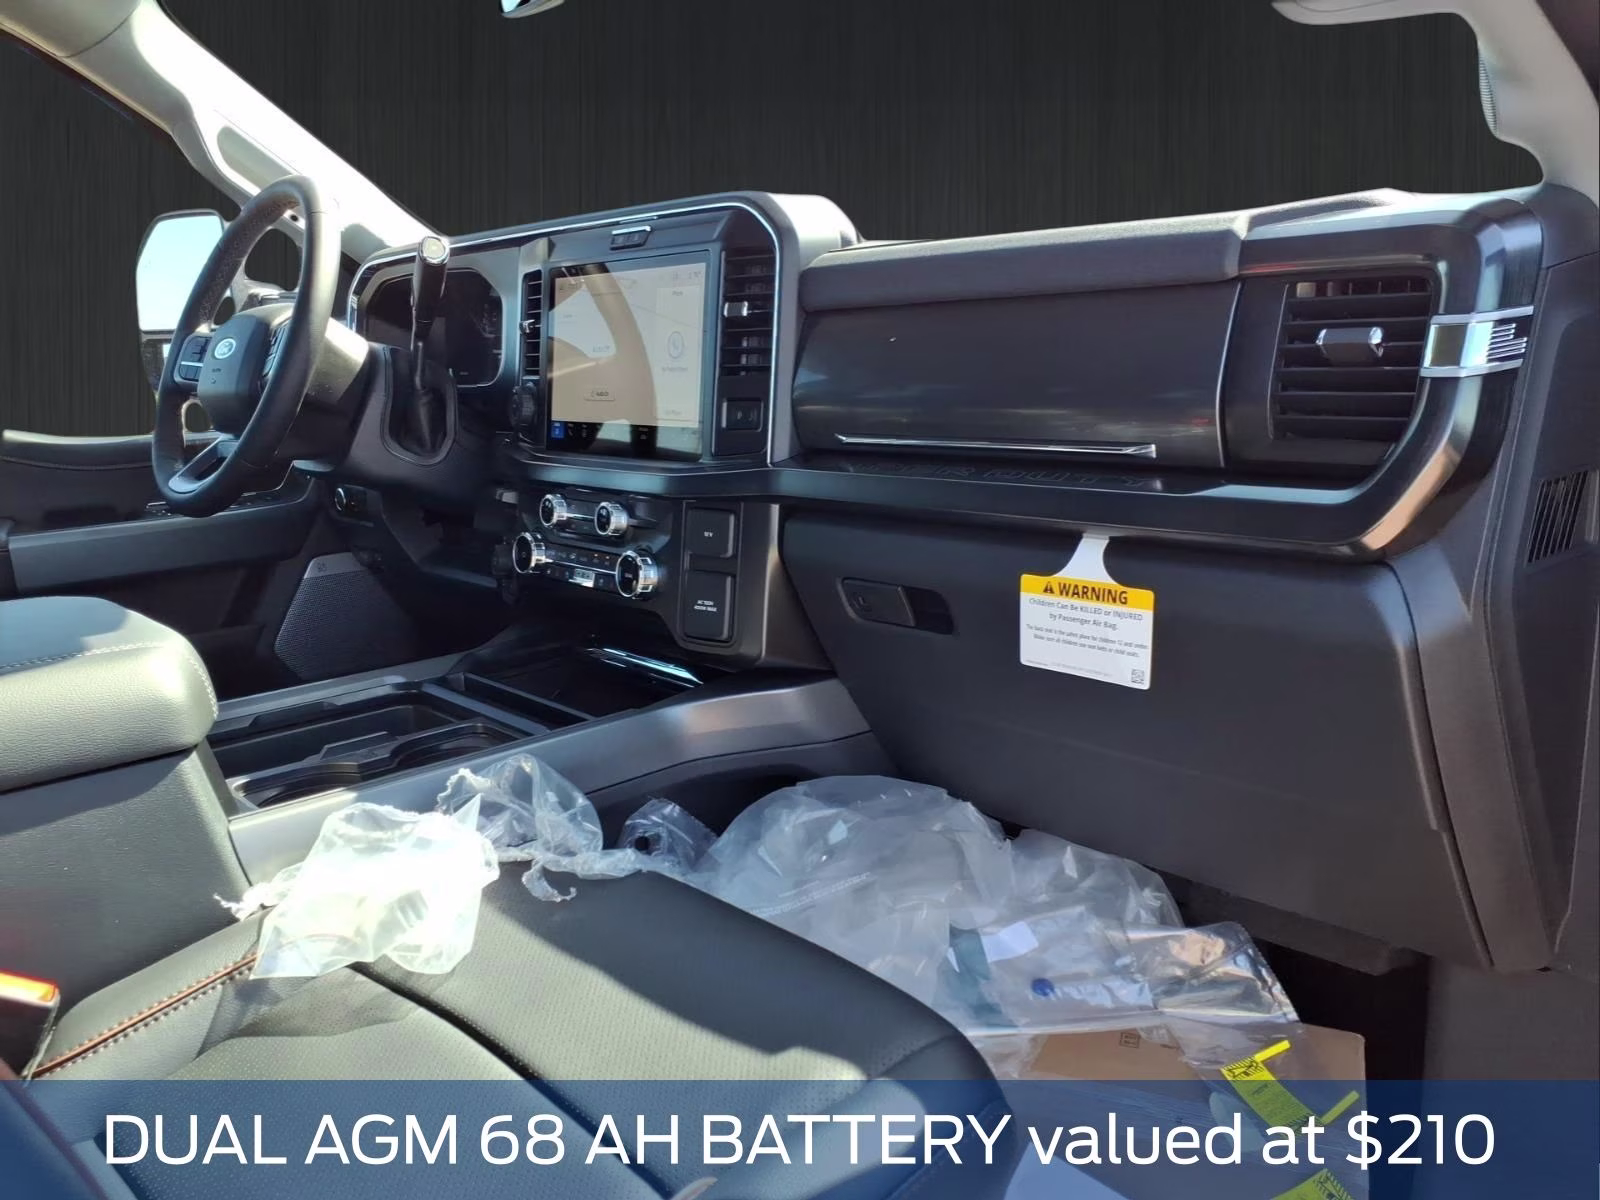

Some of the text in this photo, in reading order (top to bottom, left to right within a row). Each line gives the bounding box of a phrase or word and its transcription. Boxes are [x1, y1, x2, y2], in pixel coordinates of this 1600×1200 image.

[1058, 582, 1128, 605] WARNING
[1029, 597, 1056, 607] Children
[1056, 601, 1070, 610] Can
[1070, 603, 1079, 611] Be
[1080, 605, 1103, 615] KILLED
[1112, 610, 1143, 621] INJURED
[1049, 612, 1057, 621] by
[1058, 613, 1091, 626] Passenger
[1092, 618, 1102, 627] Air
